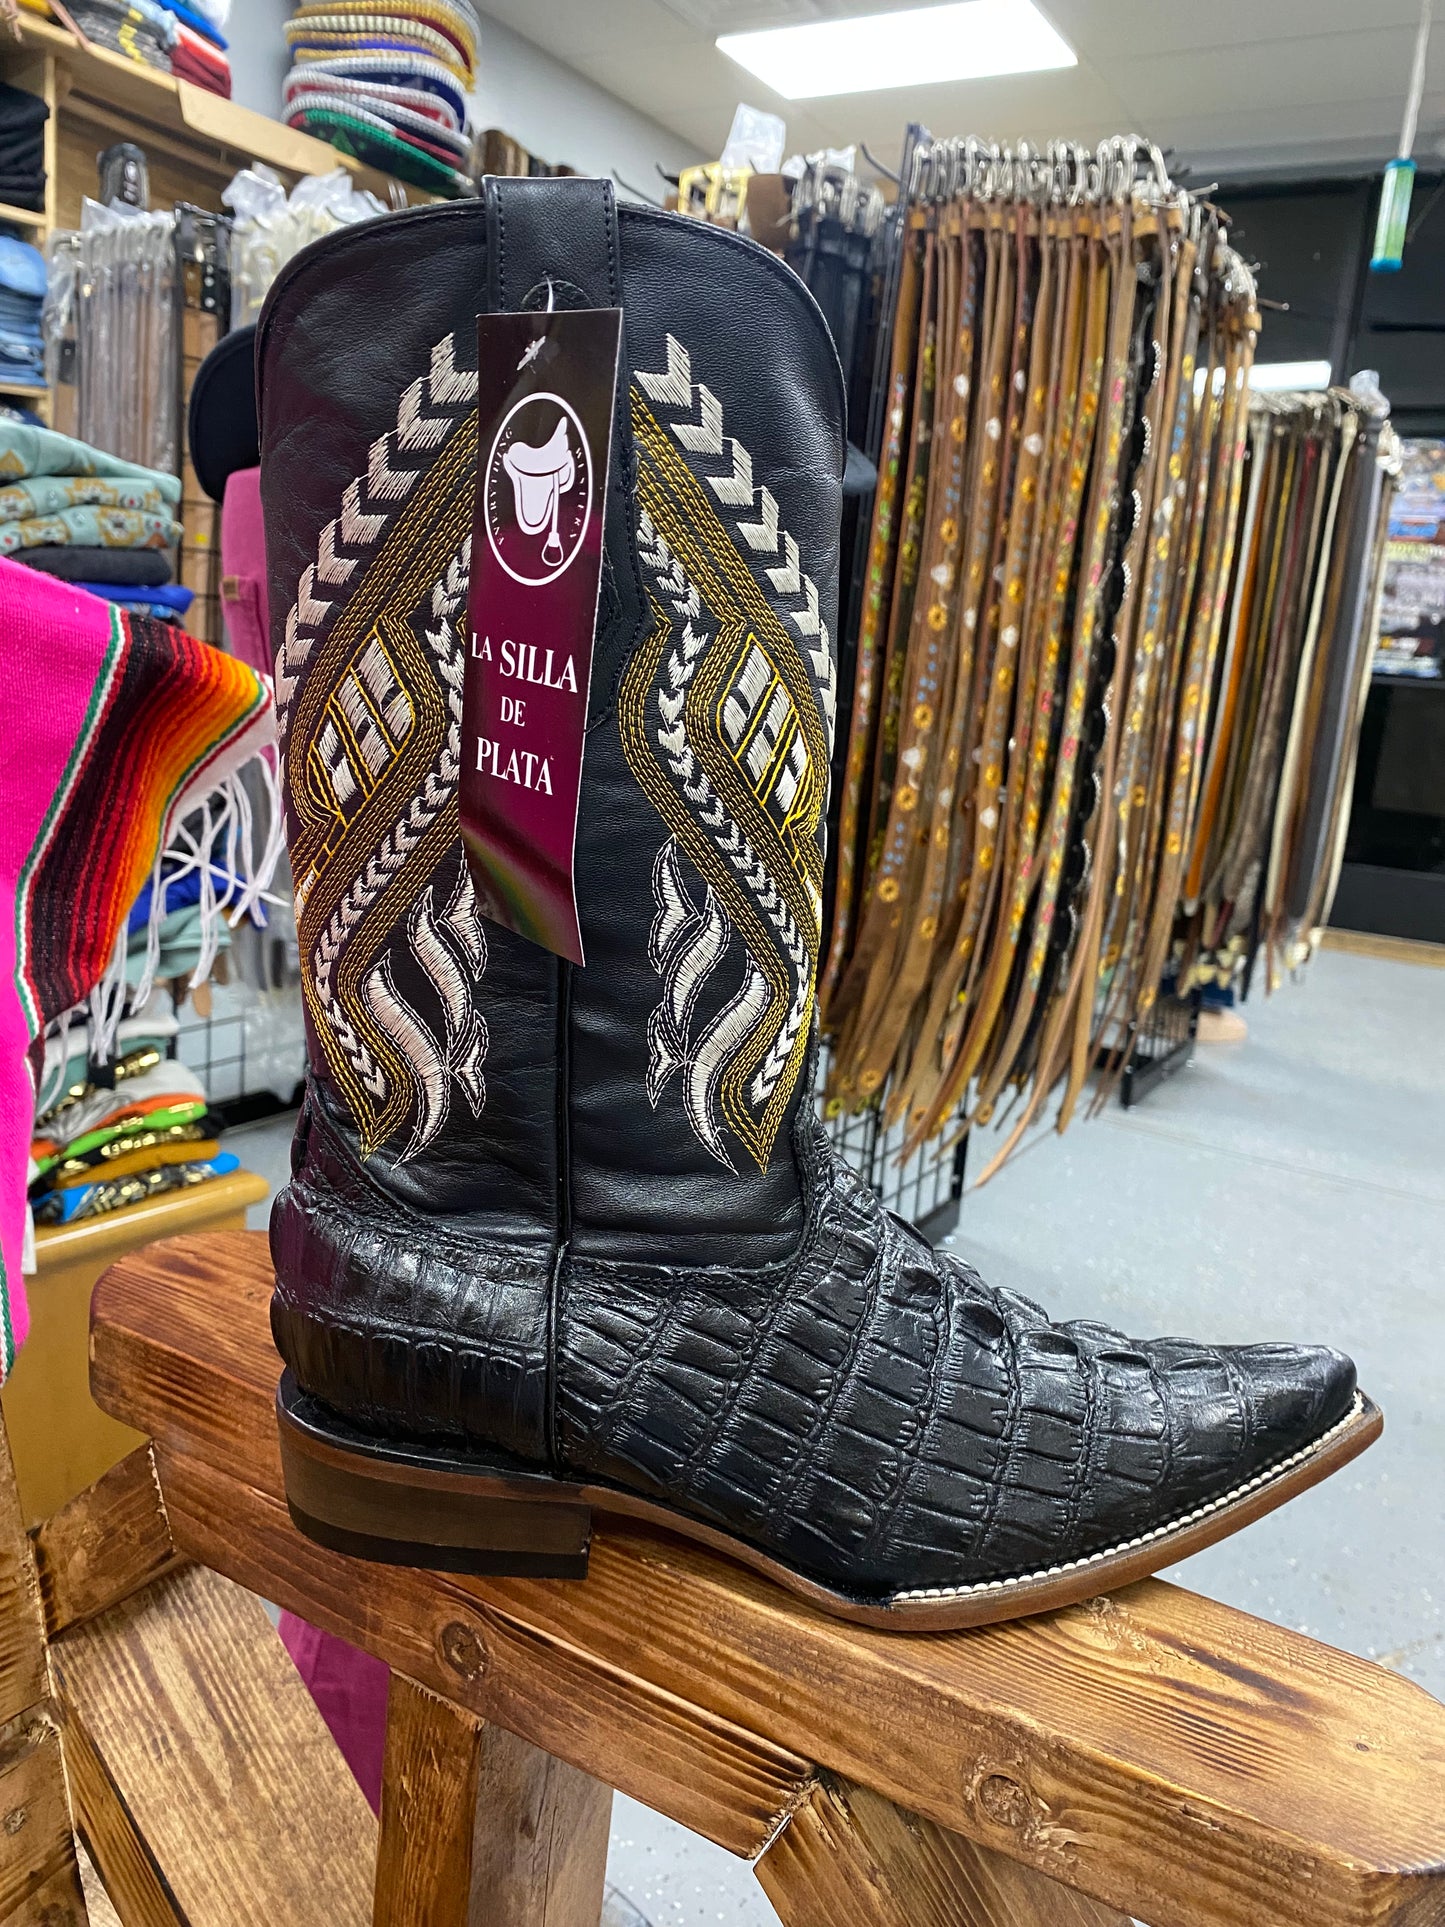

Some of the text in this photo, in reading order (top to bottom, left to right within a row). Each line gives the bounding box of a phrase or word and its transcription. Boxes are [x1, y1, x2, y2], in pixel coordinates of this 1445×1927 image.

[471, 632, 578, 694] LA SILLA
[500, 695, 527, 727] DE
[475, 736, 553, 796] PLATA
